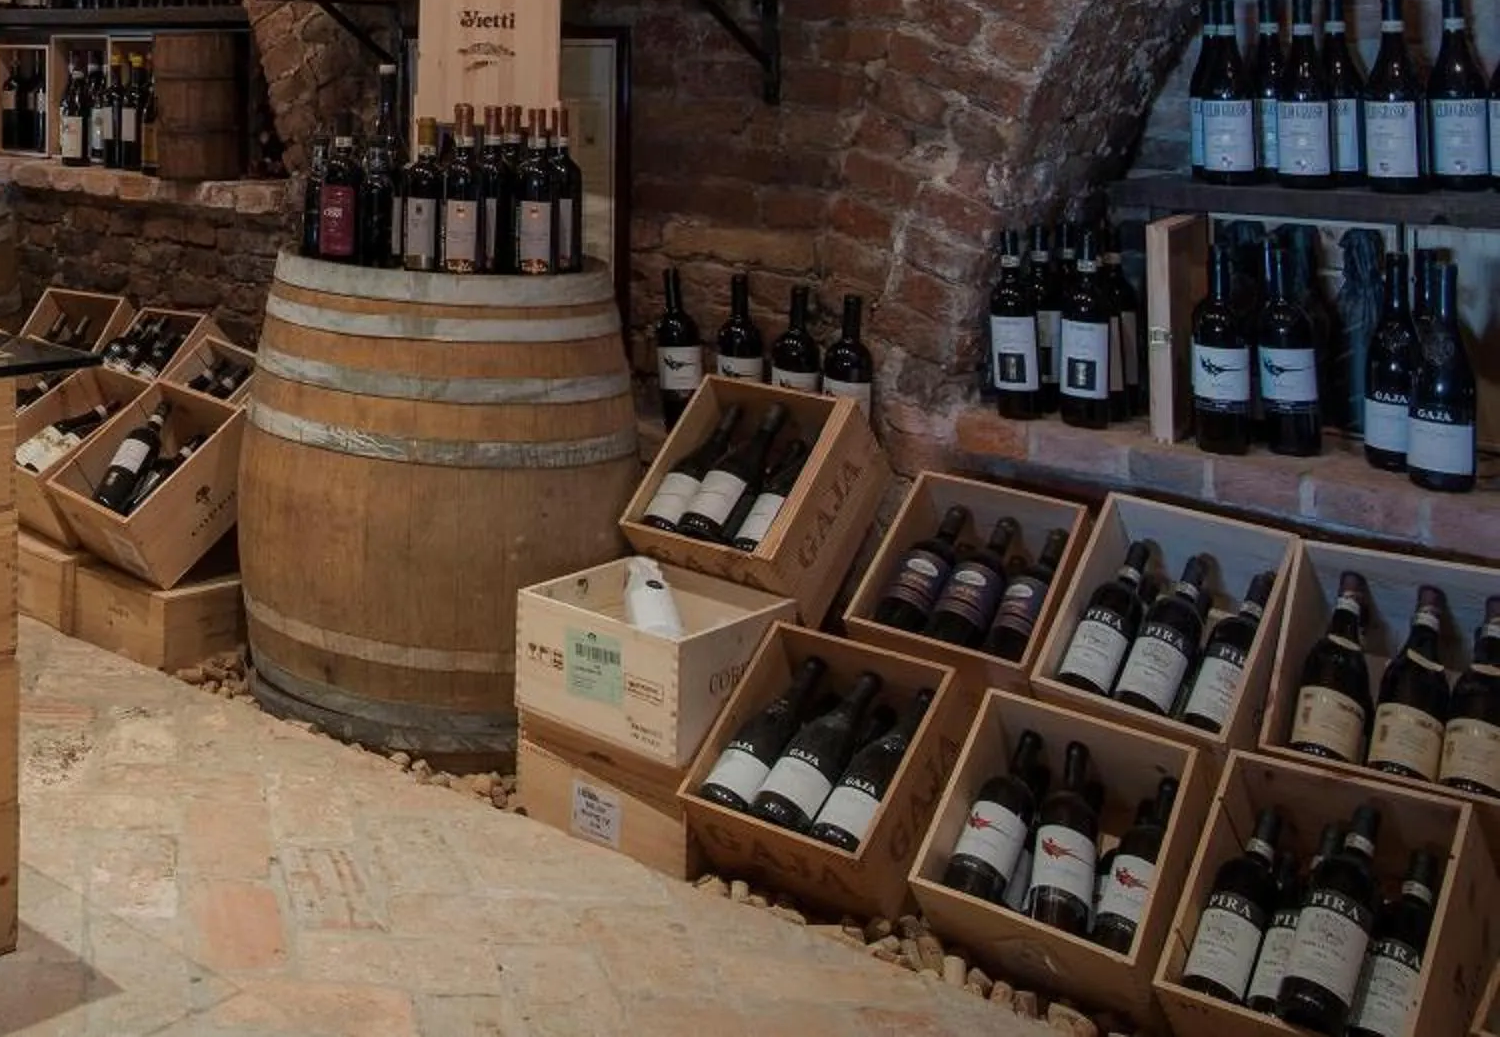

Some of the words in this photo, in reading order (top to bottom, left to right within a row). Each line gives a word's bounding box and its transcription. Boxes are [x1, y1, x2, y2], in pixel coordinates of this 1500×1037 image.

[1086, 609, 1122, 631] PIRA
[1146, 626, 1185, 651] PIRA
[1209, 893, 1252, 918] PIRA
[1311, 891, 1361, 921] PIRA
